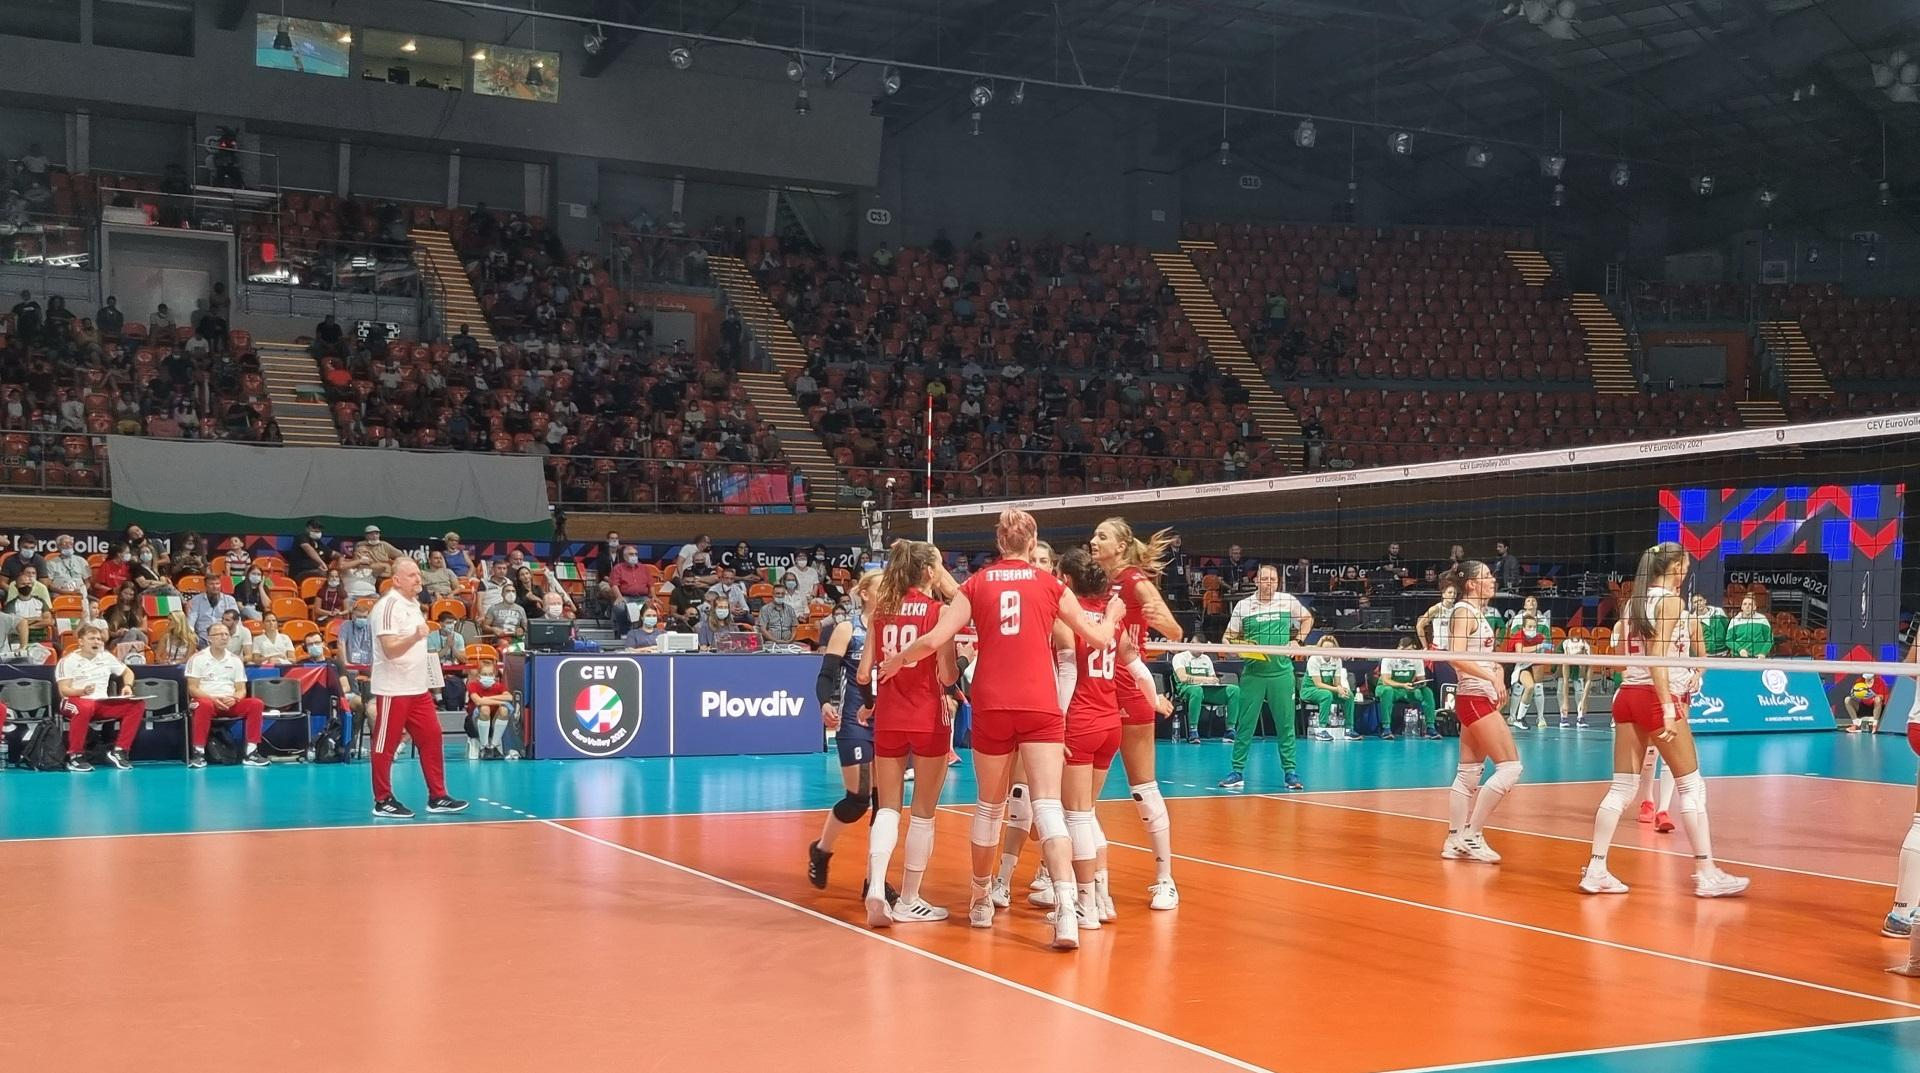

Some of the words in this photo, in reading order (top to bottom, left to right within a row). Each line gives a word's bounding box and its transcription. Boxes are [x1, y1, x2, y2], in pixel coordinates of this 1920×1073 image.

[1867, 420, 1884, 430] CEV
[1730, 572, 1750, 584] CEV
[1000, 589, 1021, 636] 9
[580, 665, 618, 680] CEV
[702, 689, 805, 718] Plovdiv
[572, 728, 611, 748] EuroVolley
